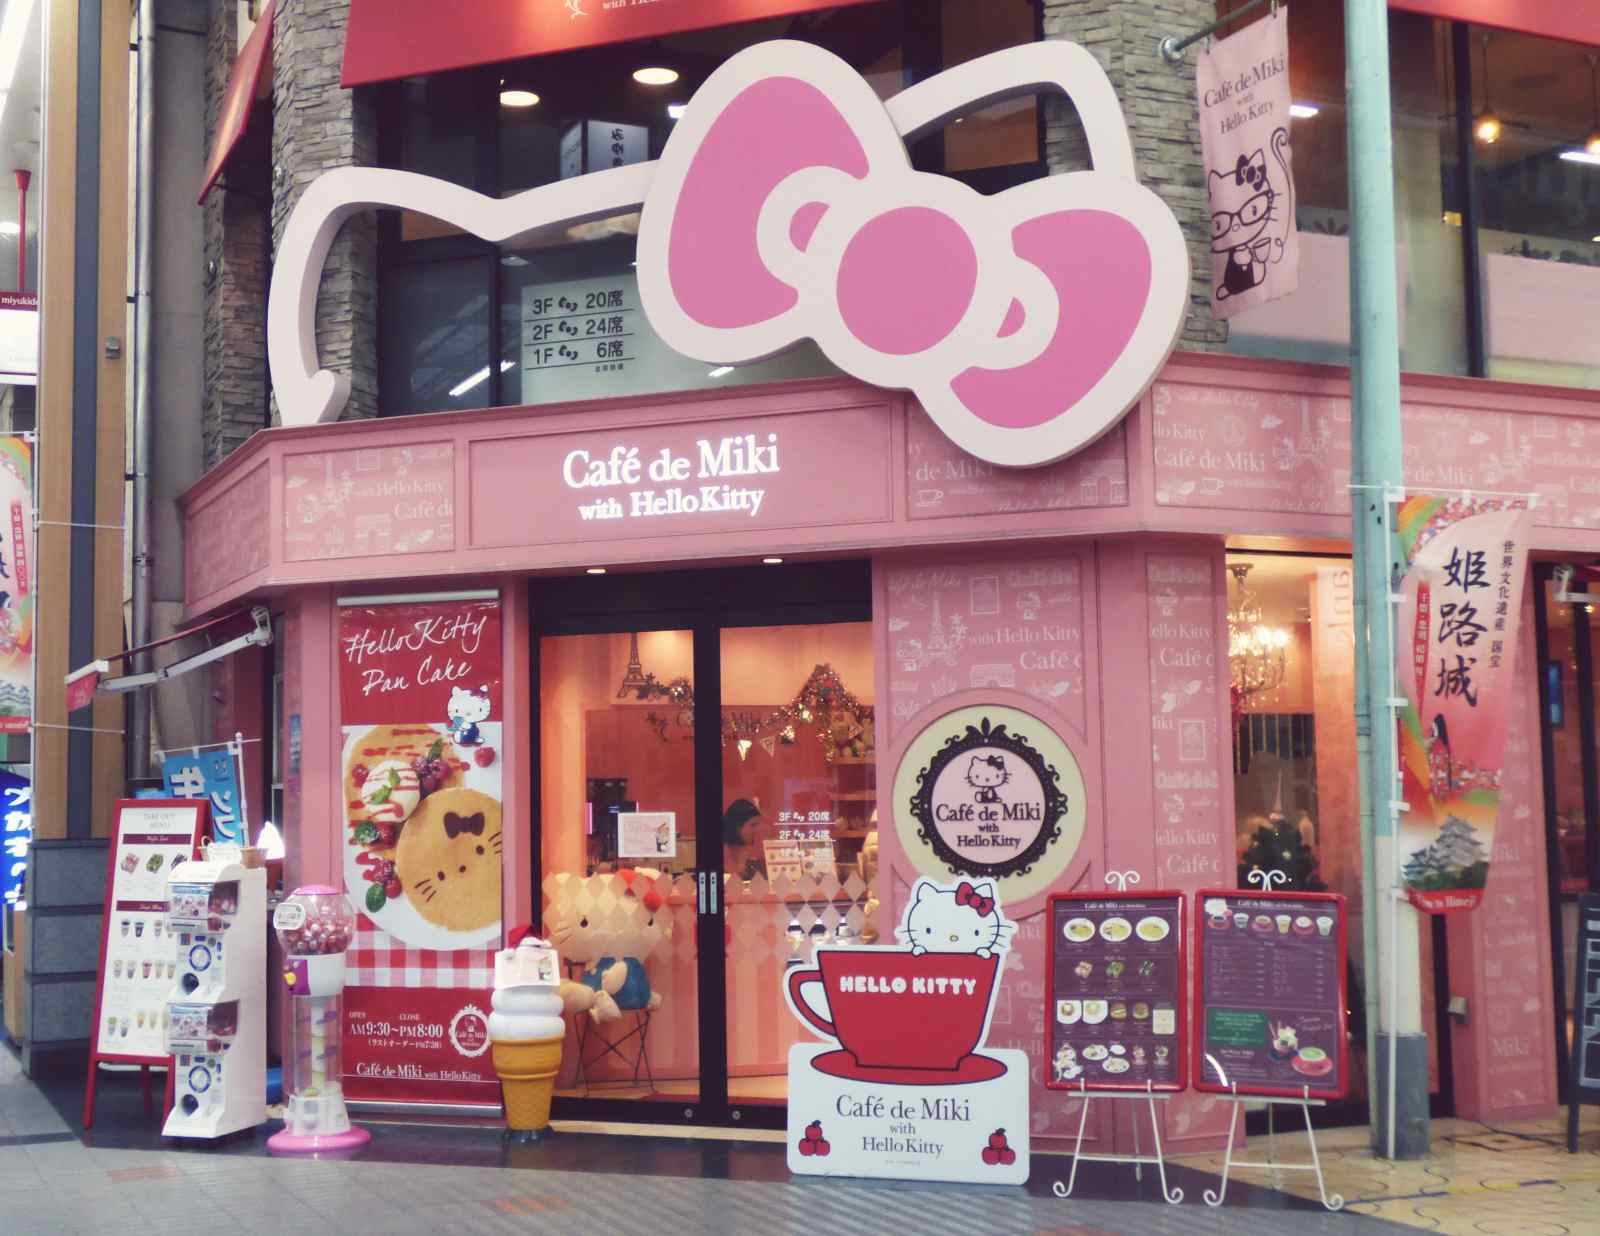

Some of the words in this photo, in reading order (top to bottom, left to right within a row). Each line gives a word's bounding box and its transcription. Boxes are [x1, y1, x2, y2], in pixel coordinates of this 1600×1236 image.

[532, 297, 554, 315] 3F
[532, 323, 554, 341] 2F
[533, 346, 554, 365] 1F
[562, 446, 642, 489] Café
[648, 448, 691, 482] de
[697, 433, 781, 479] Miki
[577, 498, 624, 521] with
[1434, 545, 1491, 708] 姫路城
[362, 668, 409, 697] Pan
[416, 655, 472, 686] Cake
[778, 811, 791, 822] 3F
[935, 803, 975, 822] Café
[978, 805, 999, 822] de
[1002, 802, 1041, 822] Miki
[778, 829, 791, 841] 2F
[978, 823, 1000, 833] with
[839, 975, 907, 994] HELLO
[912, 977, 977, 996] KITTY
[356, 1062, 382, 1077] Café
[382, 1064, 396, 1076] de
[397, 1064, 423, 1079] Miki
[836, 1094, 885, 1119] Café
[890, 1099, 916, 1120] de
[920, 1097, 972, 1122] Miki
[889, 1122, 916, 1135] with
